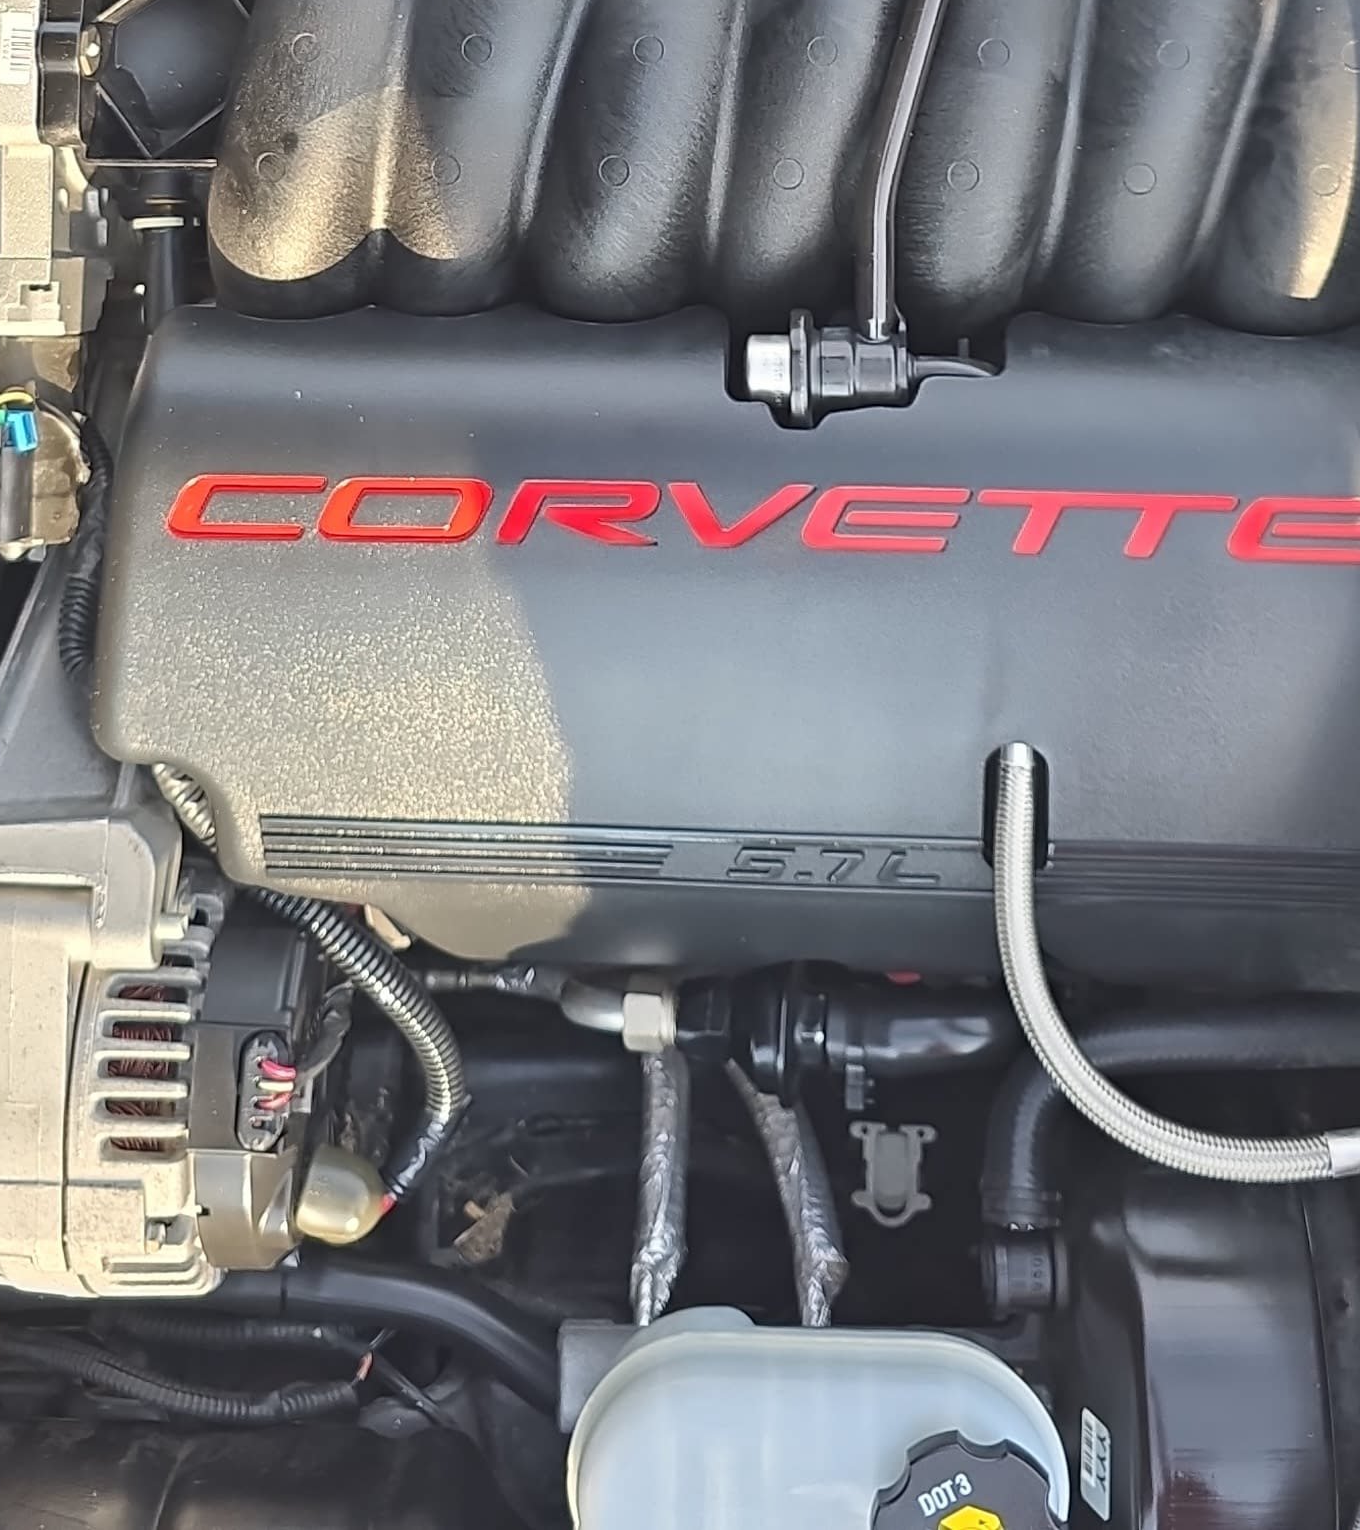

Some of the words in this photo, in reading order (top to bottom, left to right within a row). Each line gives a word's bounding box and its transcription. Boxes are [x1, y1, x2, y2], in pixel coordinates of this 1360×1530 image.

[725, 845, 941, 884] 5.7L
[917, 1481, 959, 1517] DOT
[954, 1472, 973, 1496] 3
